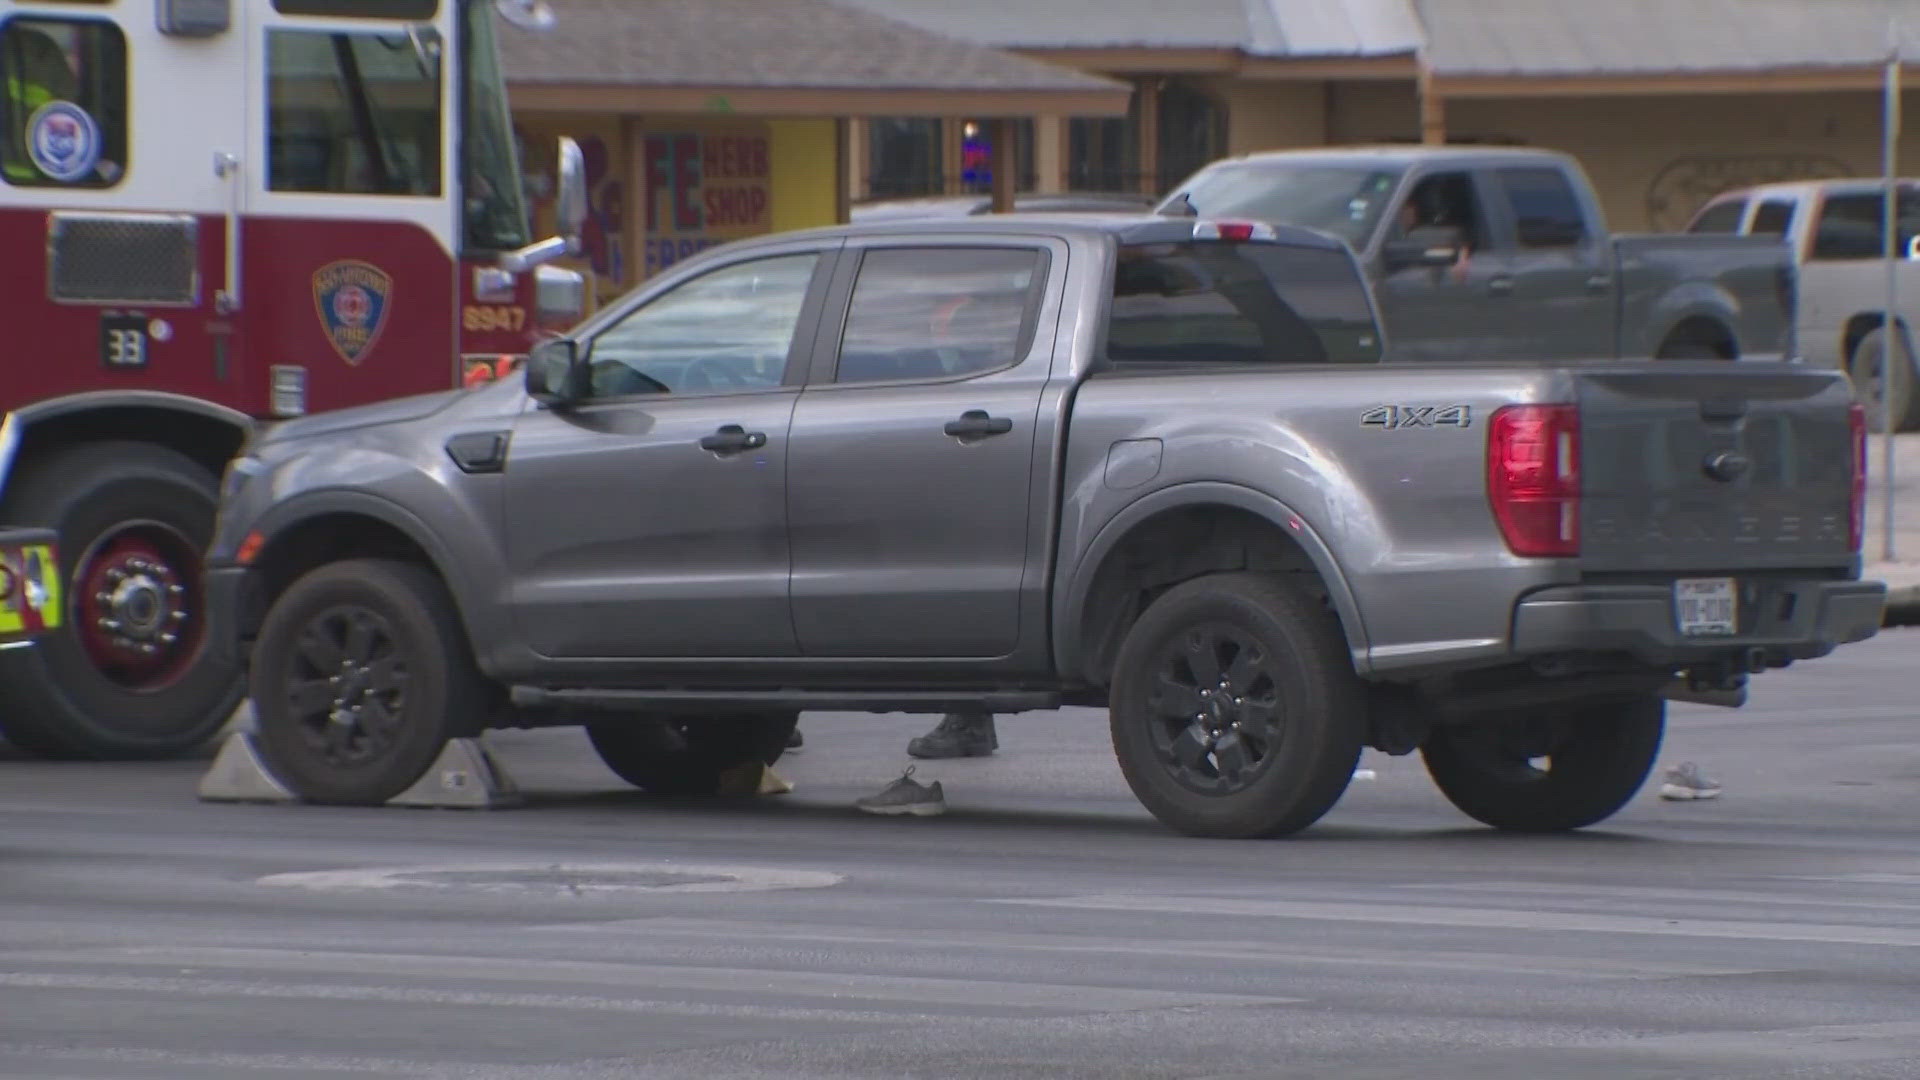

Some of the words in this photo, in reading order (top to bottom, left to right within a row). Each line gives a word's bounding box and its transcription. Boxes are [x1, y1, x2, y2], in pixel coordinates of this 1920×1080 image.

[704, 136, 768, 178] HERB
[704, 186, 767, 227] SHOP
[108, 329, 143, 364] 33
